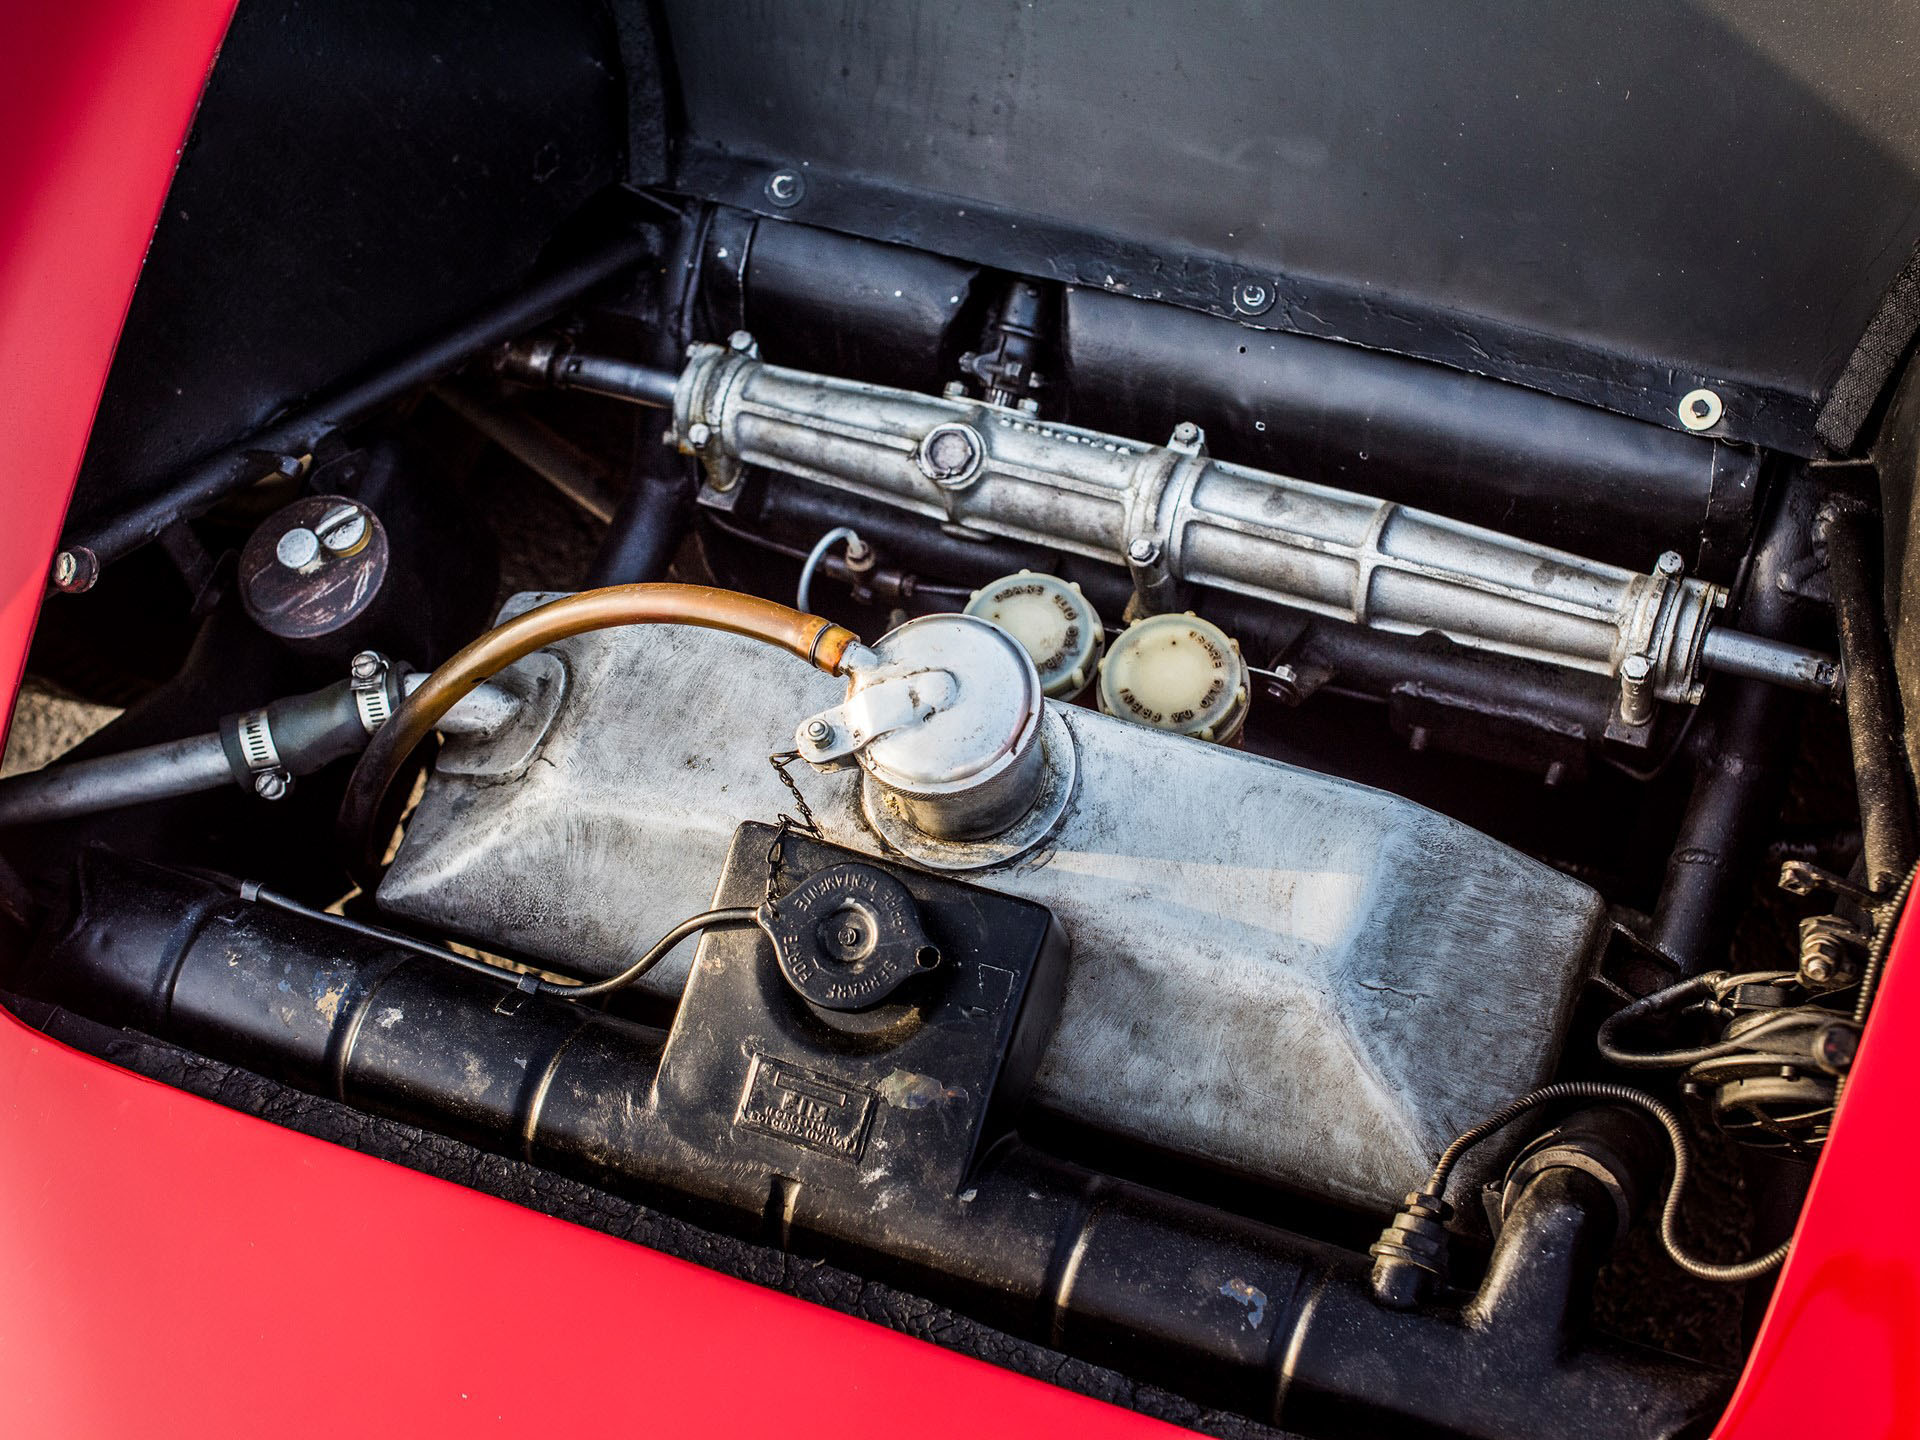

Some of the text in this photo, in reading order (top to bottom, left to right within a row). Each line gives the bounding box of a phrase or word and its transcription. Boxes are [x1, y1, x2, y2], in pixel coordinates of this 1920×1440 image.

[1189, 630, 1222, 669] USARE
[1120, 688, 1162, 722] FRENI
[1171, 709, 1195, 722] DA
[783, 935, 813, 984] FORTE
